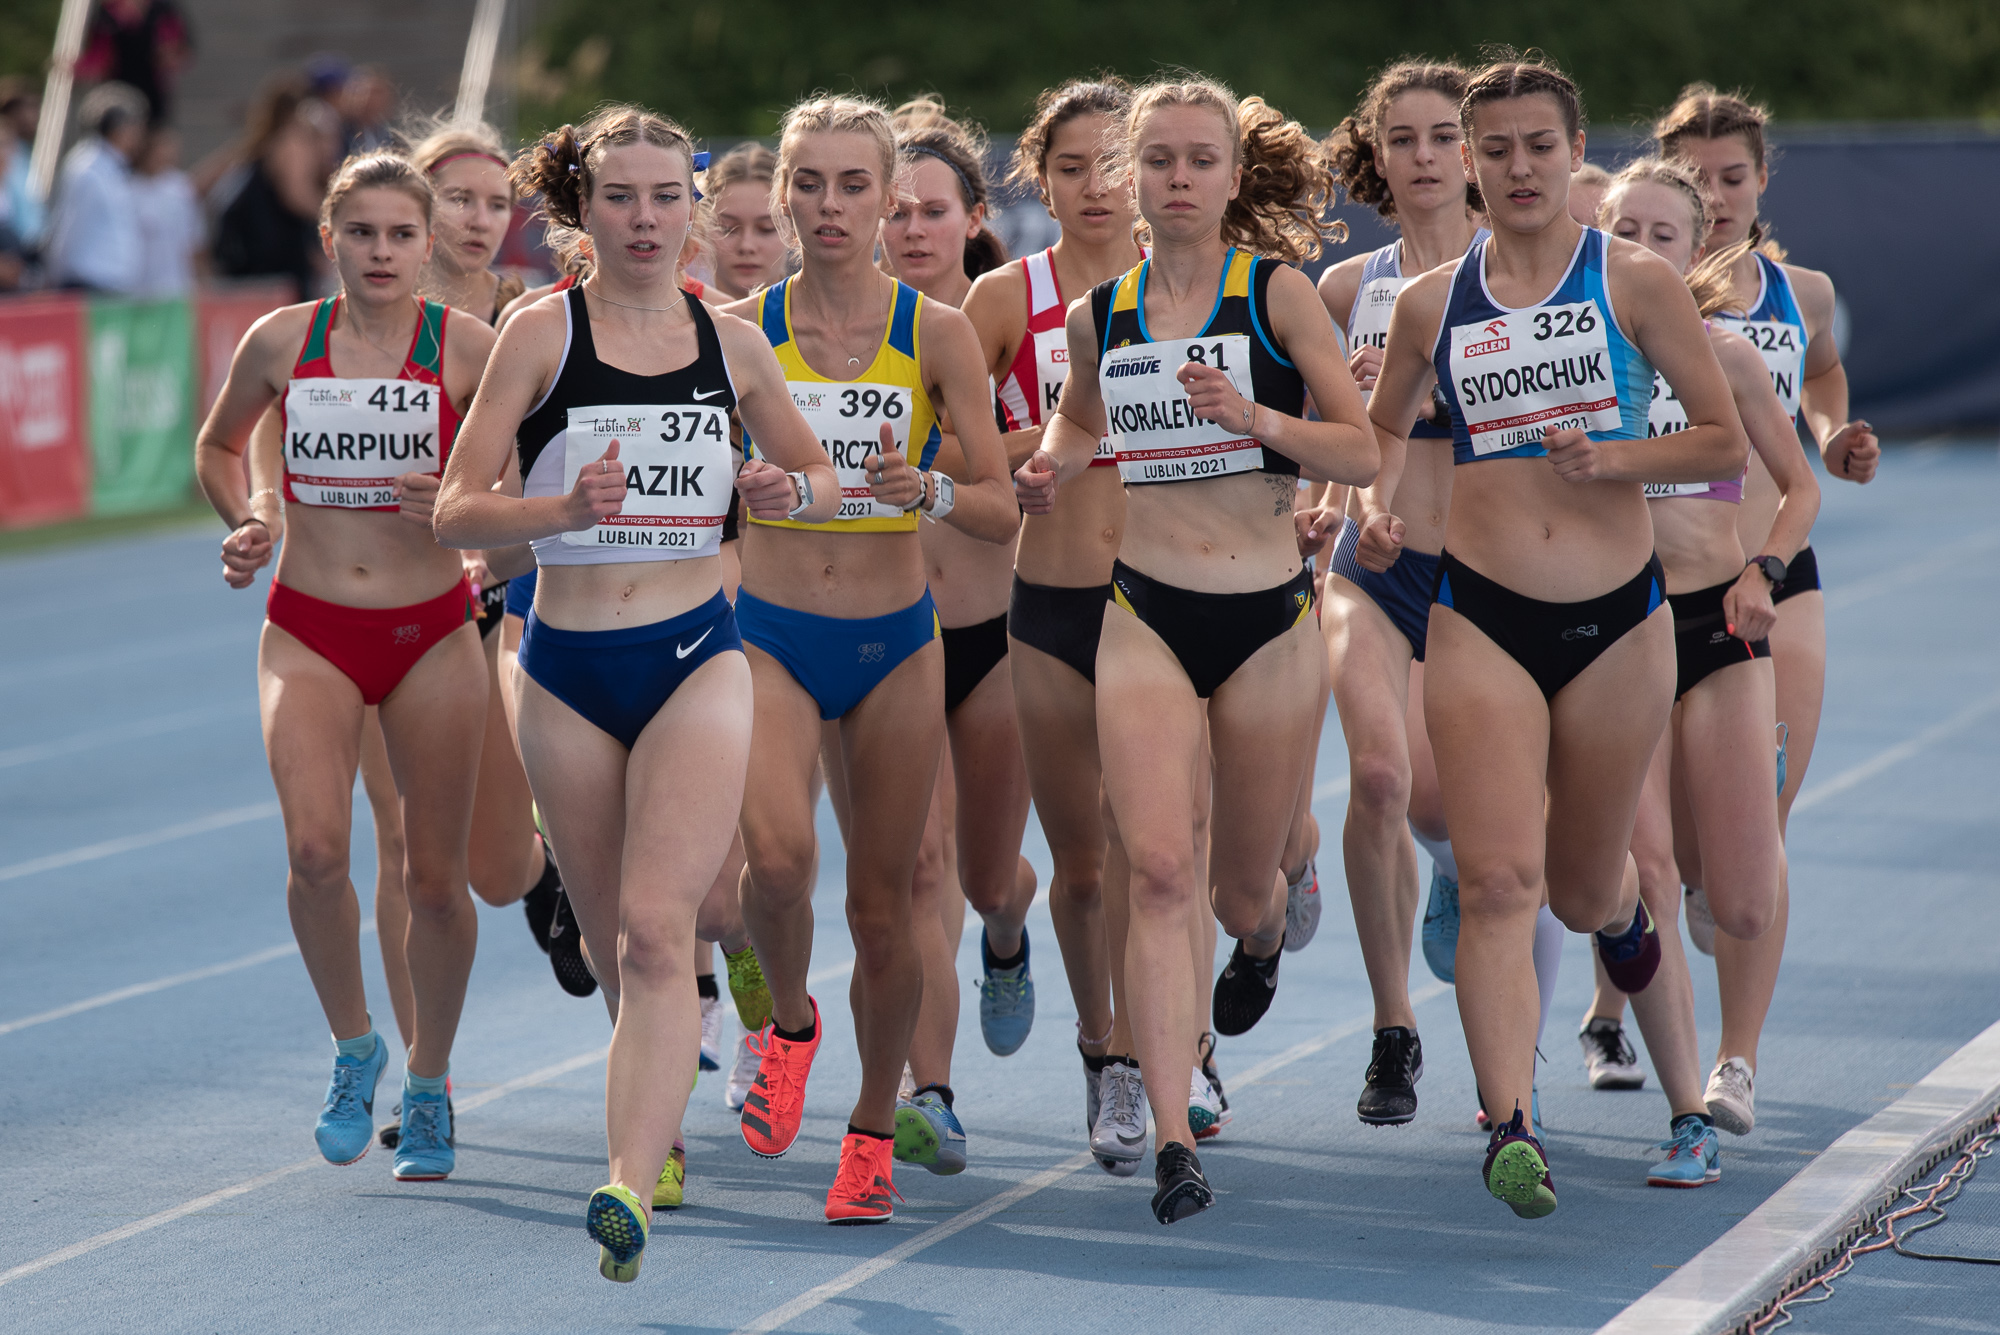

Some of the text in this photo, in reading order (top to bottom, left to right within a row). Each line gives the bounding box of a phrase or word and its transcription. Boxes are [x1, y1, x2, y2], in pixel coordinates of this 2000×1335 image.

[1533, 306, 1596, 341] 326
[1466, 339, 1508, 357] ORLEN
[1742, 326, 1796, 352] 324
[1186, 342, 1229, 371] 81
[1105, 359, 1162, 379] 4MOVE
[1461, 352, 1607, 406] SYDORCHUK
[367, 385, 431, 412] 414
[838, 389, 904, 419] 396
[659, 411, 724, 442] 374
[1487, 421, 1506, 430] PZLA
[1506, 408, 1563, 427] MISTRZOSTWA
[1563, 403, 1593, 413] POLSKI
[1594, 400, 1612, 409] U20
[292, 432, 435, 460] KARPIUK
[1501, 426, 1547, 447] LUBLIN
[1150, 448, 1203, 459] MISTRZOSTWA
[1203, 443, 1235, 453] POLSKI
[1236, 440, 1254, 448] U20
[1144, 457, 1227, 479] LUBLIN 2021
[626, 465, 704, 497] AZIK
[1643, 483, 1677, 494] 2021
[320, 490, 368, 505] LUBLIN
[838, 502, 872, 516] 2021
[609, 516, 674, 525] MISTRZOSTWA
[675, 517, 707, 526] POLSKI
[707, 517, 723, 525] U20
[598, 530, 696, 546] LUBLIN 2021
